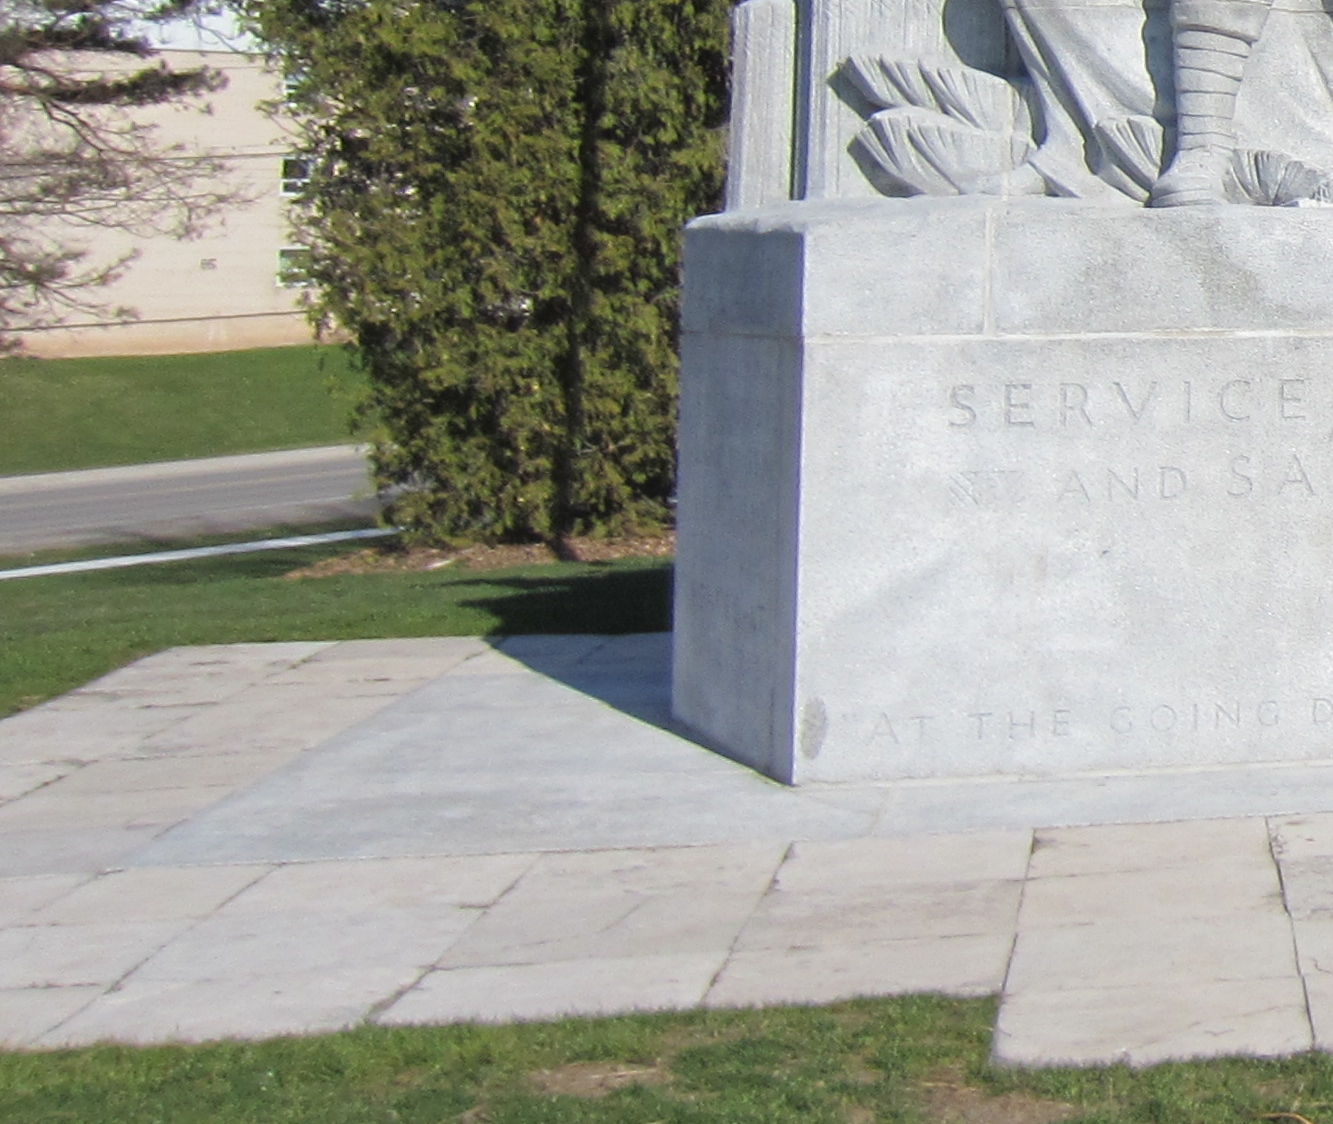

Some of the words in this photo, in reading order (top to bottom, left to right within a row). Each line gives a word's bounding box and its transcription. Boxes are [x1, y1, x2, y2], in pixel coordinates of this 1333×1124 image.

[947, 378, 1308, 428] SERVICE
[1057, 466, 1189, 505] AND
[969, 708, 1071, 740] THE
[1108, 699, 1281, 735] GOING
